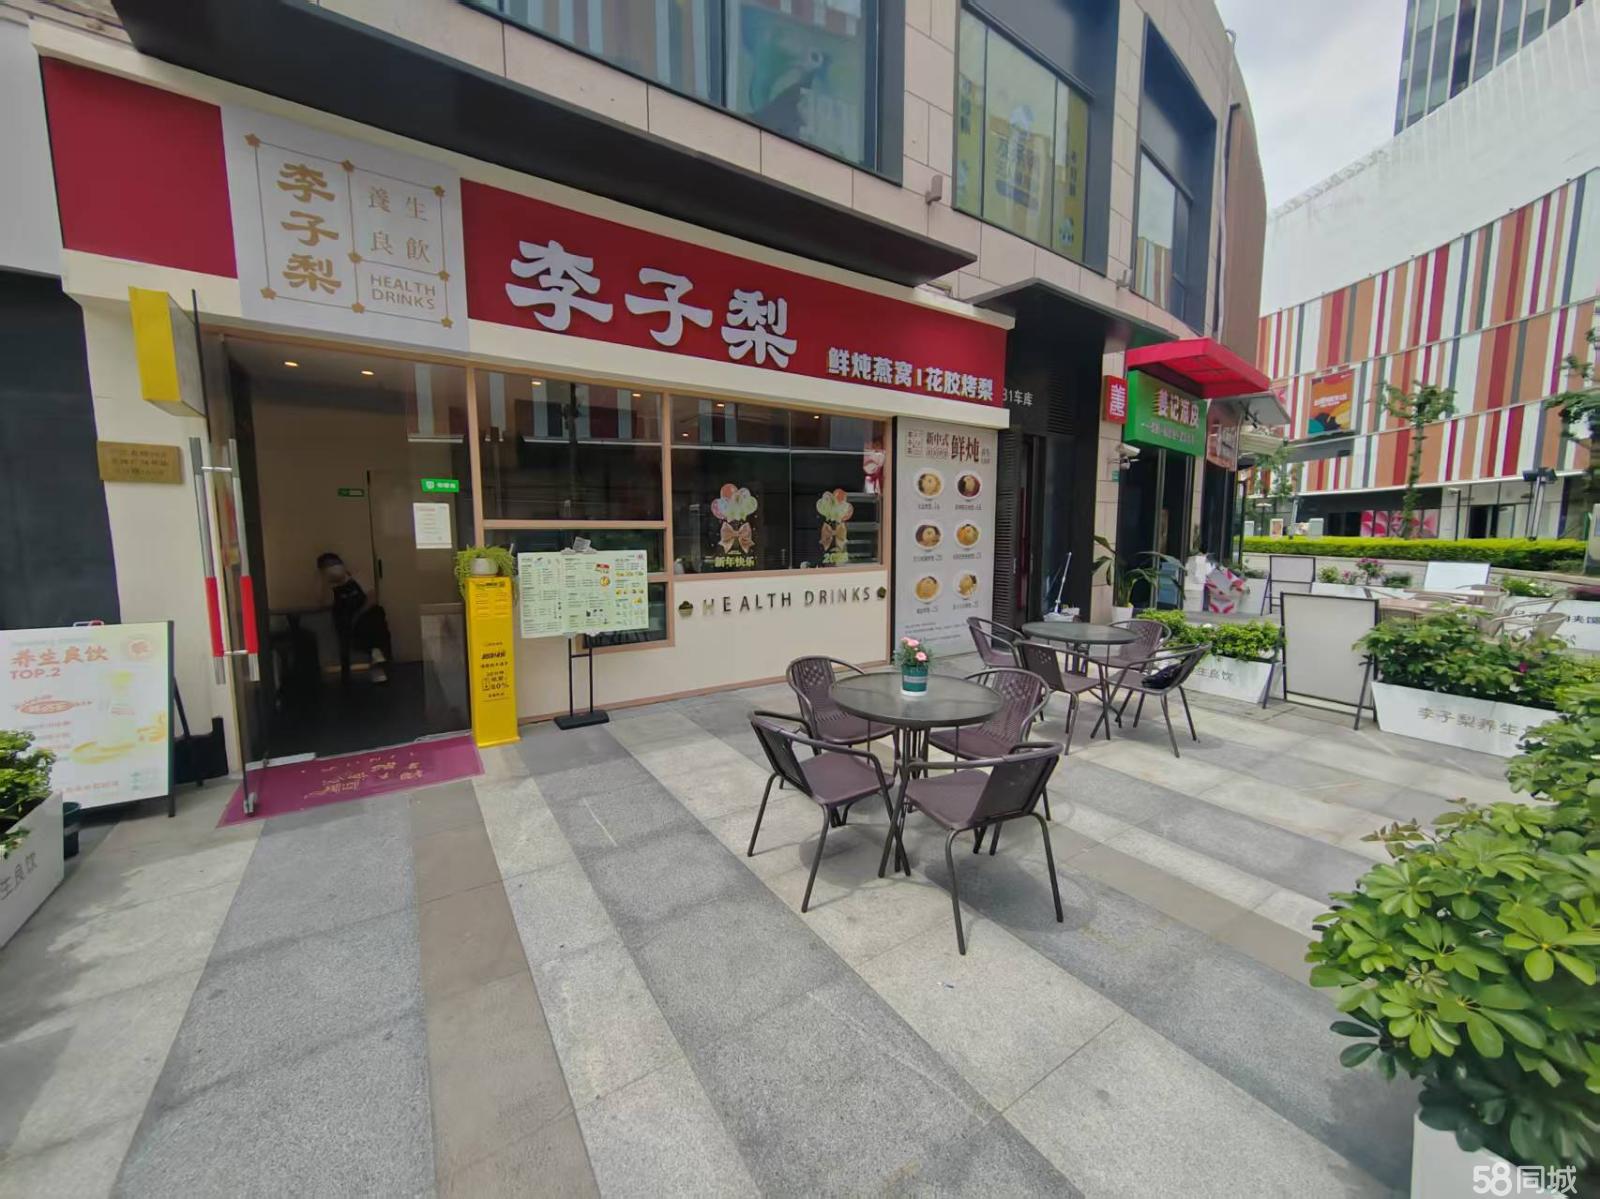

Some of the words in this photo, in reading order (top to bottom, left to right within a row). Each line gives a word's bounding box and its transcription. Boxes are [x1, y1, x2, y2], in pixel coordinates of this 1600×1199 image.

[277, 163, 342, 295] 李子梨
[370, 274, 437, 297] HEALTH
[371, 288, 436, 310] DRINKS
[505, 239, 798, 369] 李子梨
[951, 434, 980, 463] 鲜炖
[702, 591, 792, 616] HEALTH
[804, 586, 871, 606] DRINKS
